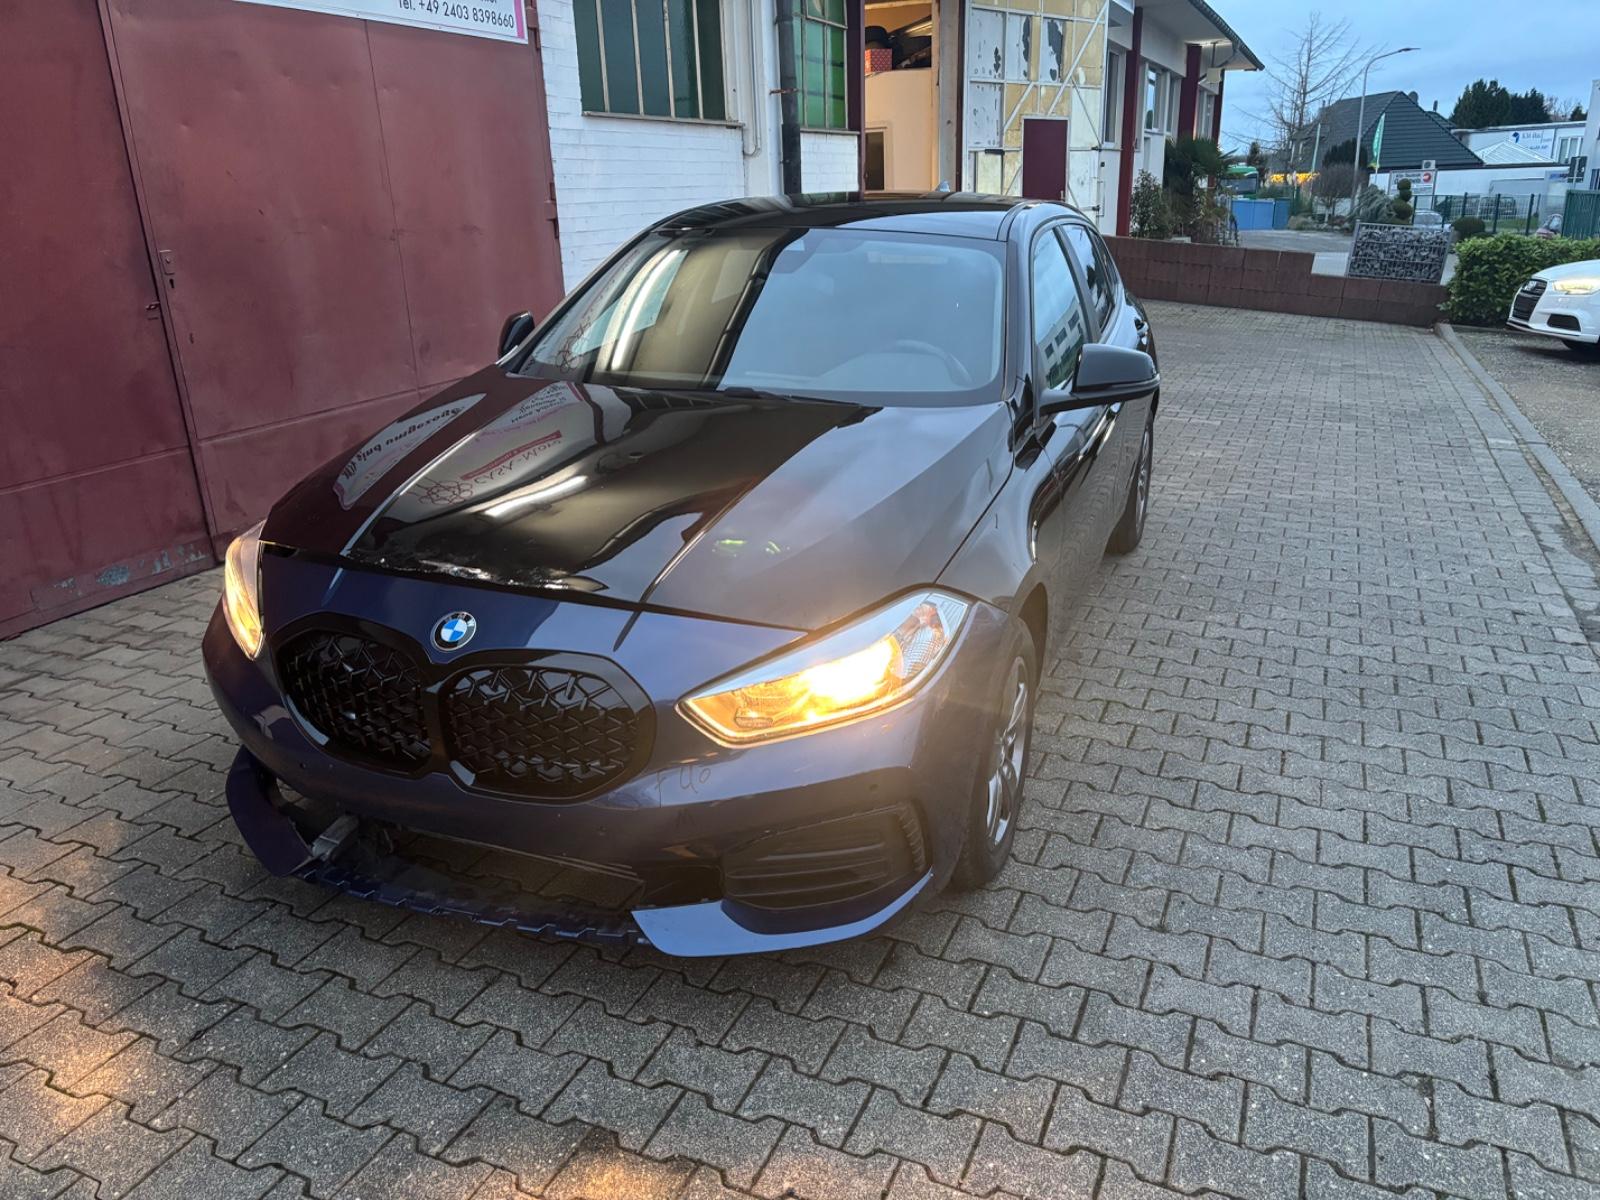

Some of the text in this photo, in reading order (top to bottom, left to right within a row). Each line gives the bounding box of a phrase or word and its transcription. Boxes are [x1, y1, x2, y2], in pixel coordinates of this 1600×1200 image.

[418, 0, 439, 14] +49
[442, 2, 469, 20] 2403
[472, 7, 514, 28] 8398660
